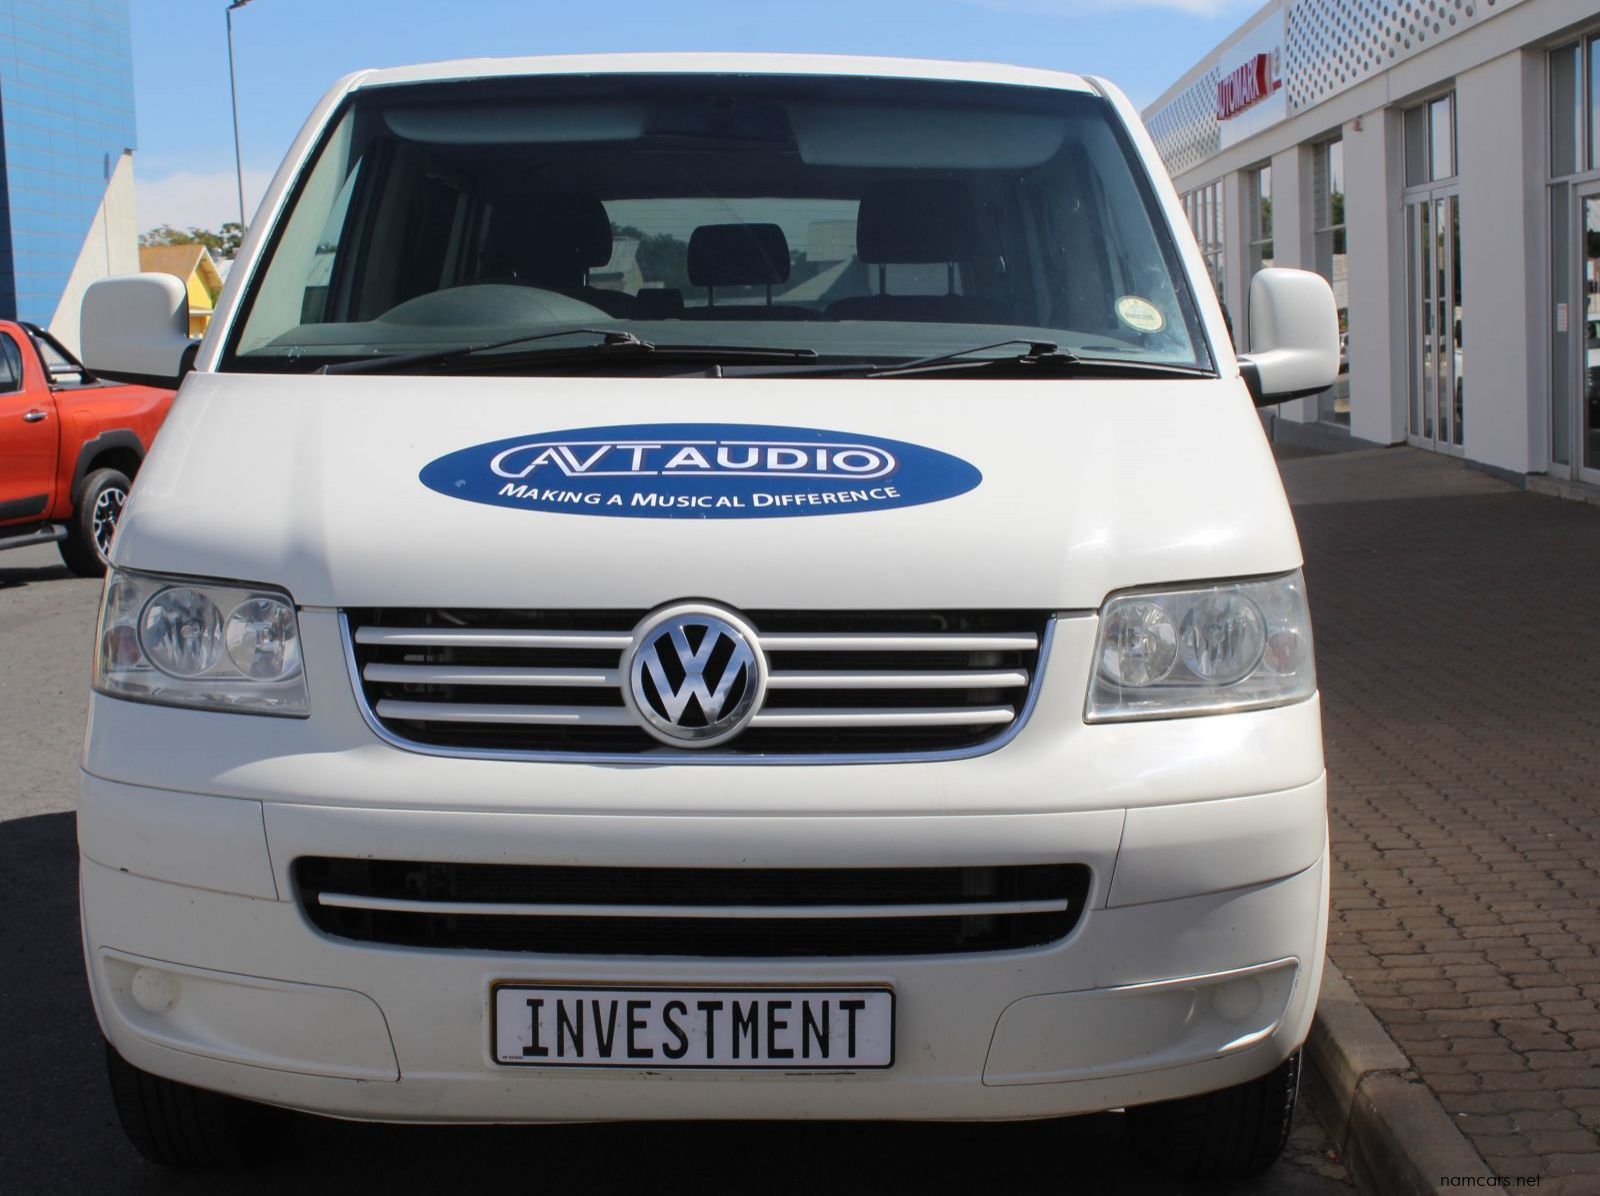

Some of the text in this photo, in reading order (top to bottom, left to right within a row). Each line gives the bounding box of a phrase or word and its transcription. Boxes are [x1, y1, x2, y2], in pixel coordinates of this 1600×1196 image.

[1215, 55, 1259, 120] AUTOMARK
[664, 446, 881, 472] AUDIO
[522, 998, 866, 1059] INVESTMENT
